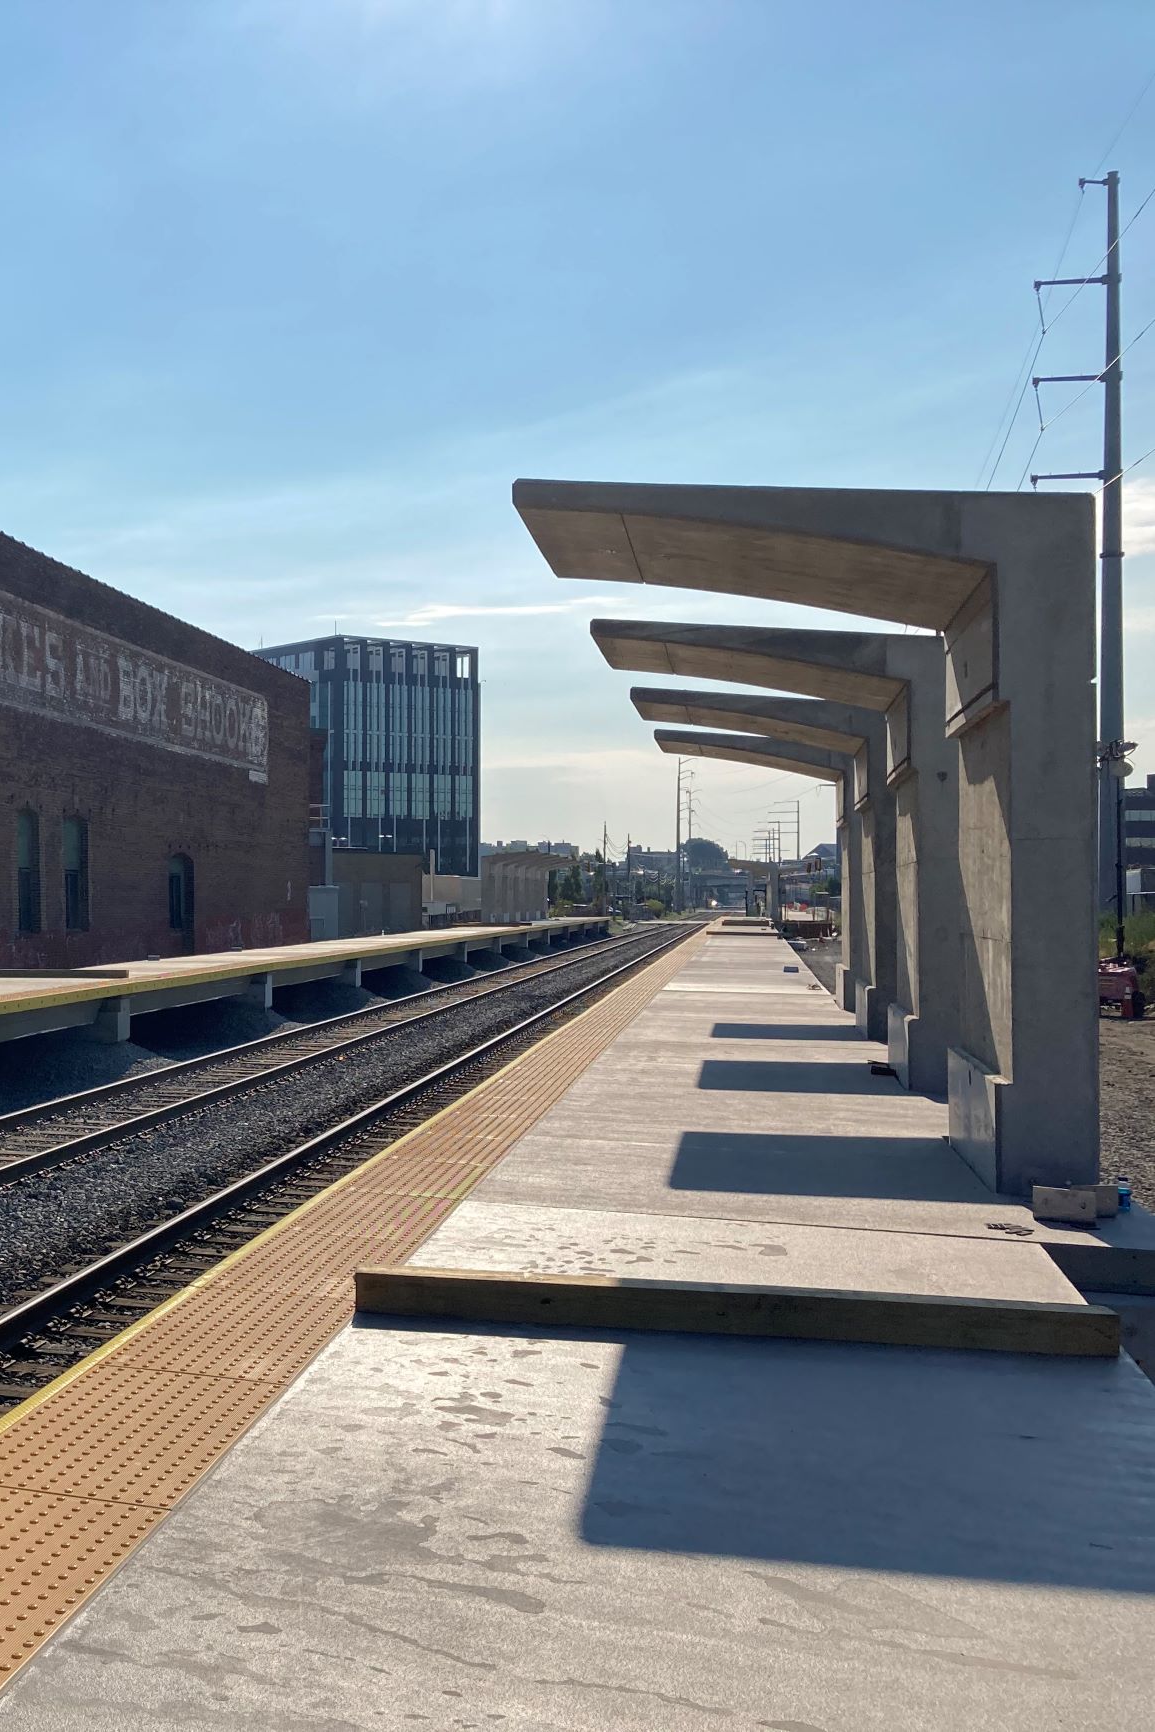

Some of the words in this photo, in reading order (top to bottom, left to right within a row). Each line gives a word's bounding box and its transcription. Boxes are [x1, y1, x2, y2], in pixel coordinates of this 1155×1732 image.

[76, 647, 111, 702] AND
[117, 652, 168, 729] BOX
[180, 680, 266, 757] SHOOKS
